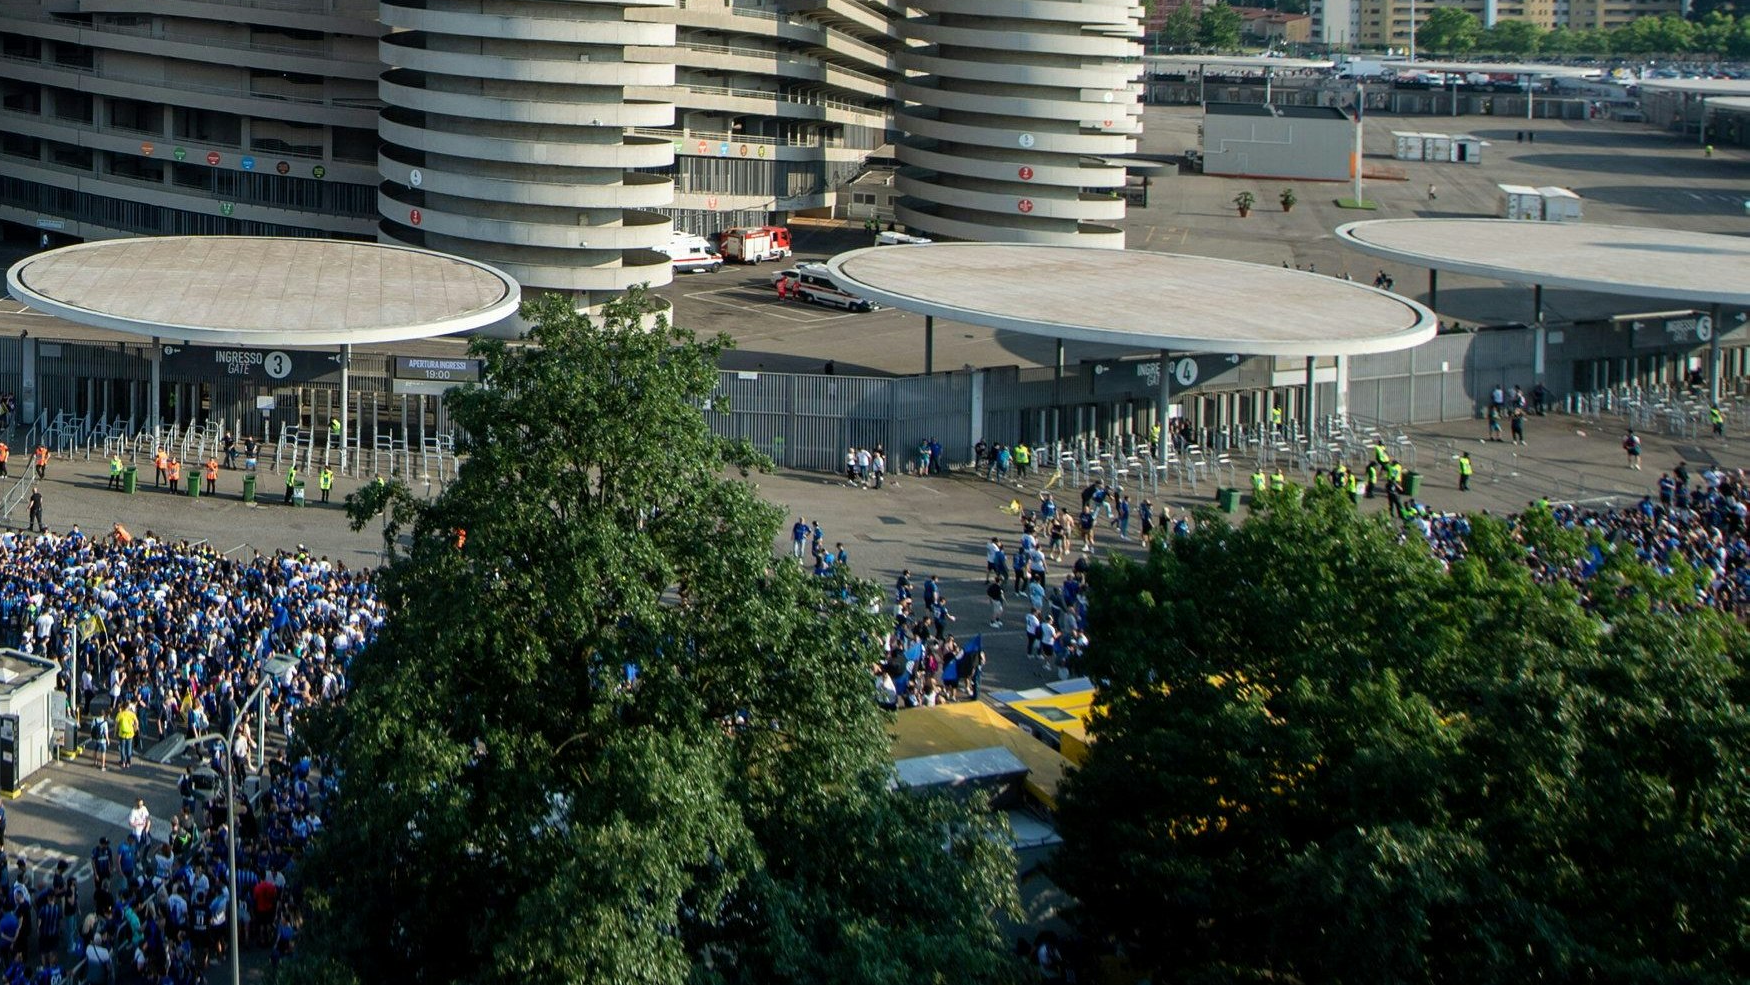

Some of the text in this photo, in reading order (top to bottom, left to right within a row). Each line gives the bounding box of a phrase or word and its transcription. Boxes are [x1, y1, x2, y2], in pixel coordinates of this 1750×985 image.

[215, 350, 263, 365] INGRESSO
[273, 355, 283, 375] 3
[408, 359, 466, 370] APERTURA INGRESSI
[227, 362, 250, 375] GATE
[425, 369, 451, 379] 19:00
[1137, 362, 1175, 377] INGREO
[1182, 361, 1191, 382] 4
